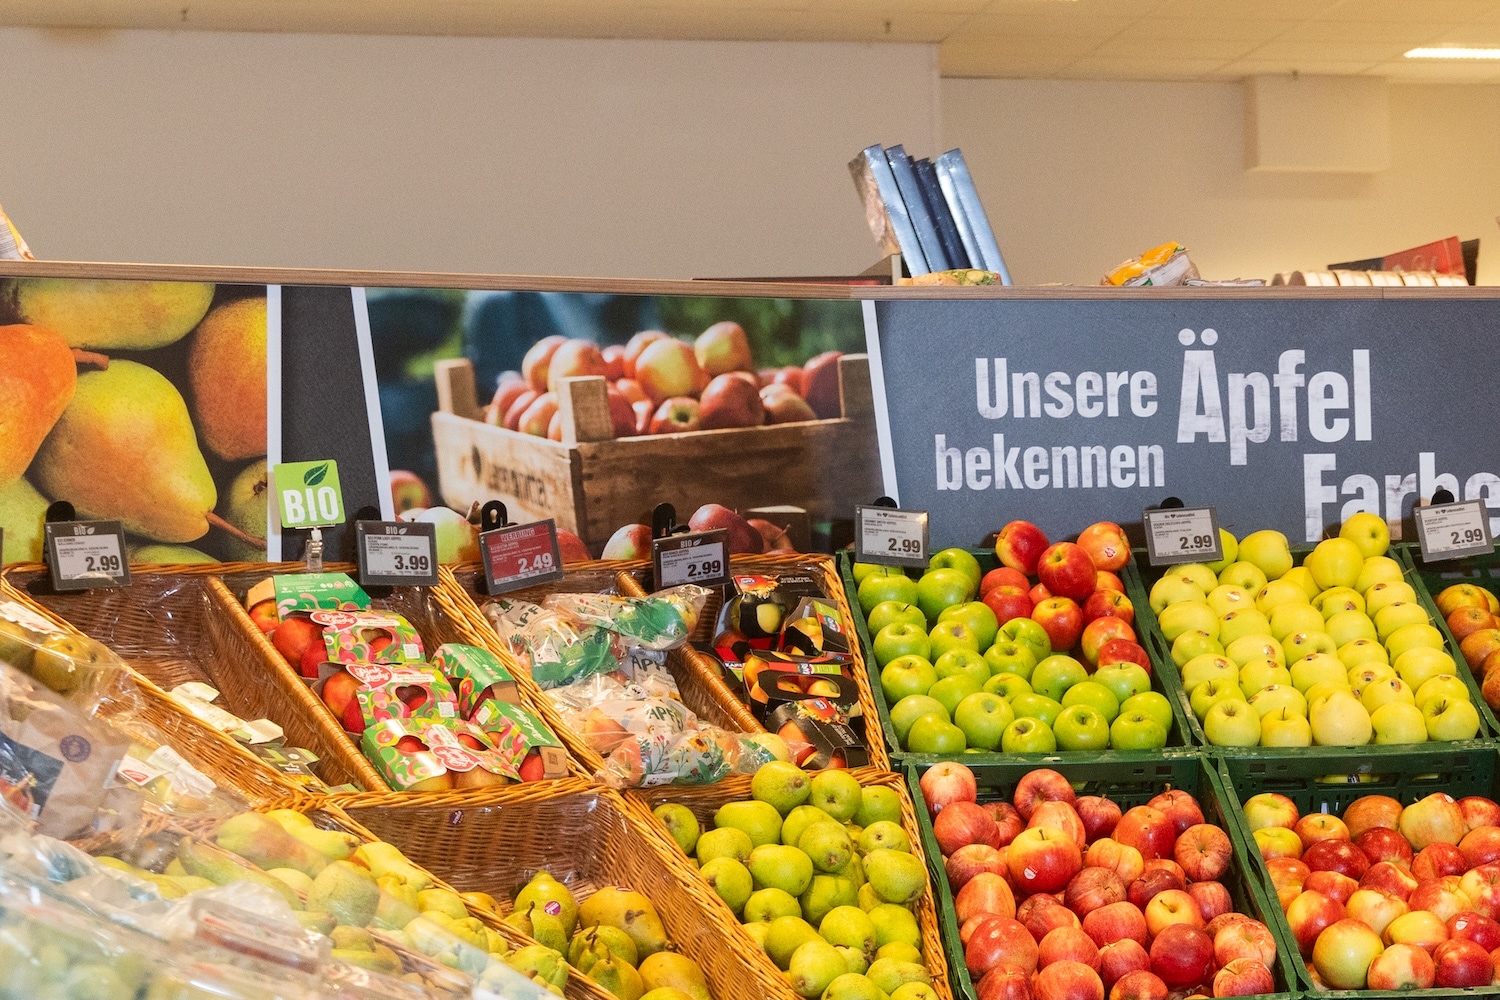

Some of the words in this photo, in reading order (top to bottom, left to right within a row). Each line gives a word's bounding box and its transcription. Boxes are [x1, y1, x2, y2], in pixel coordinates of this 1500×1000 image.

[975, 357, 1158, 419] Unsere
[1177, 328, 1372, 465] Äpfel
[935, 433, 1165, 491] bekennen
[283, 486, 339, 524] BIO
[386, 526, 398, 534] BIO
[501, 528, 535, 542] WERBUNG
[1450, 528, 1483, 544] 2.99
[680, 540, 692, 548] BIO
[888, 538, 920, 553] 2.99
[1179, 535, 1213, 549] 2.99
[85, 555, 120, 572] 2.99
[394, 555, 429, 571] 3.99
[518, 553, 553, 573] 2.49
[687, 560, 721, 577] 2.99
[320, 612, 348, 621] Pink
[332, 616, 356, 625] Lady
[356, 665, 382, 675] Pink
[365, 671, 391, 682] Lady
